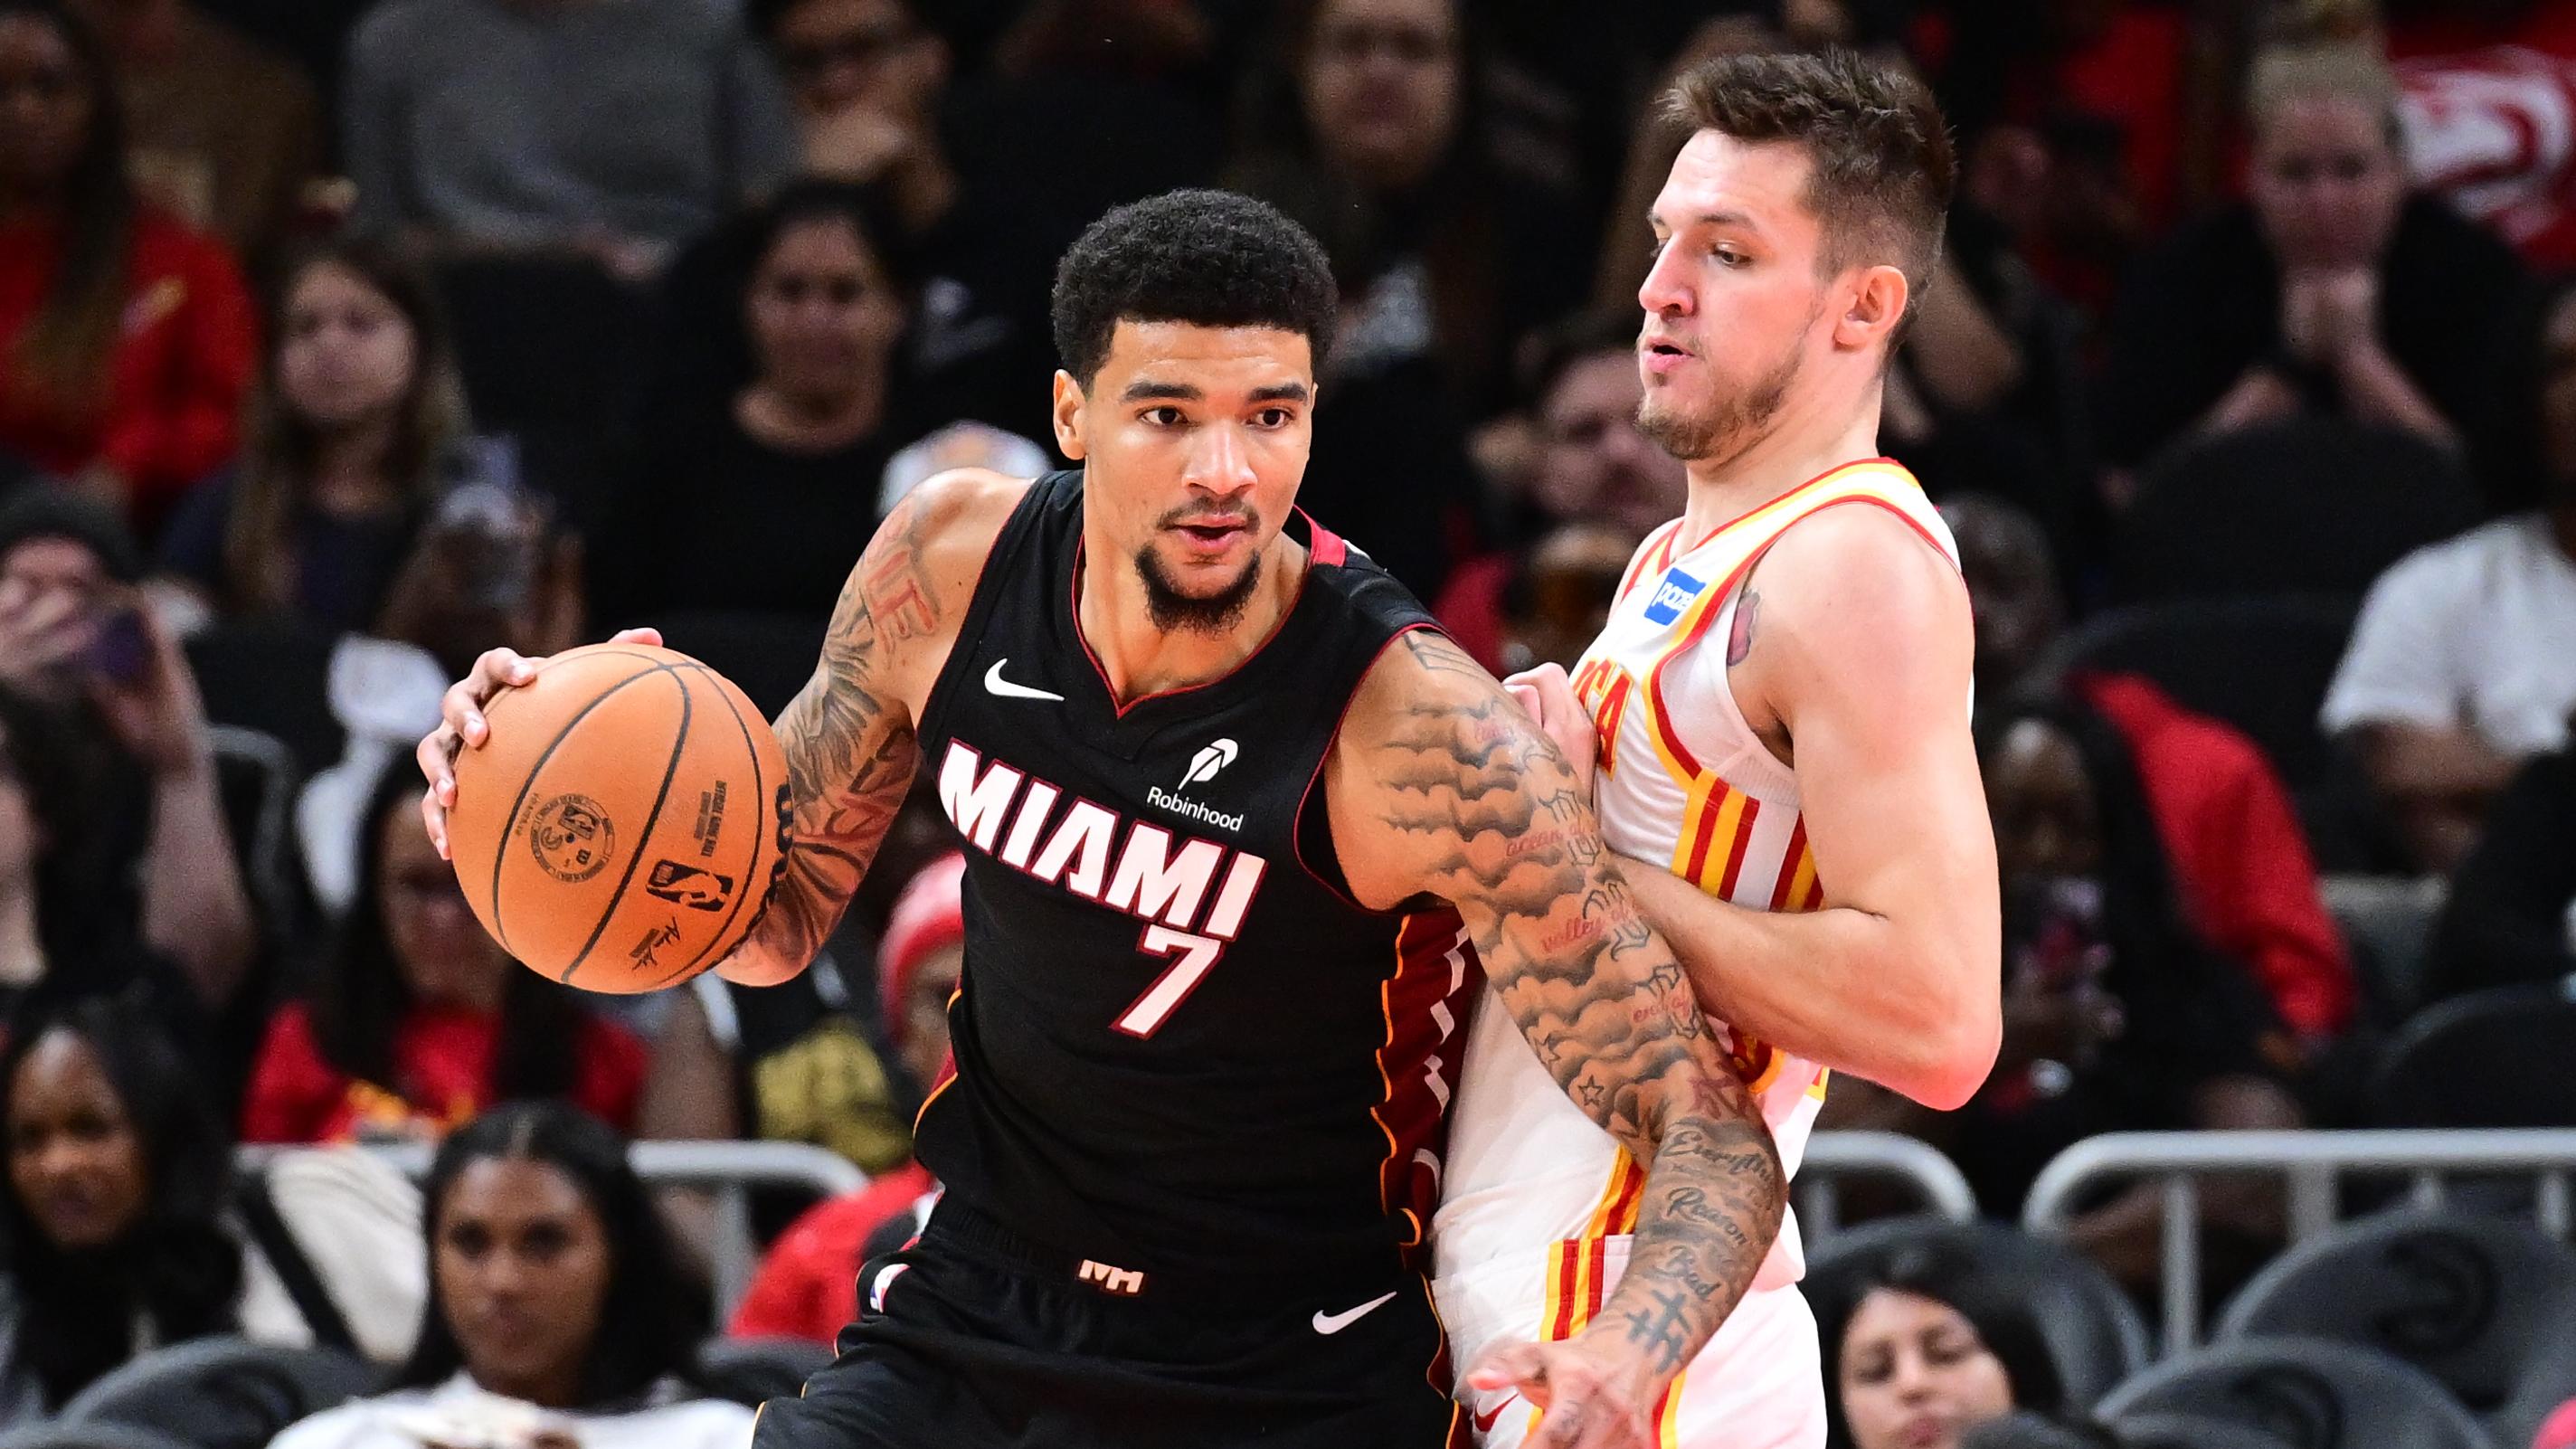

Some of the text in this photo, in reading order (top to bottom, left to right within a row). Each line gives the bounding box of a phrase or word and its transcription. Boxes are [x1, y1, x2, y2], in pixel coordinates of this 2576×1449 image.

[937, 737, 1268, 942] MIAMI
[1147, 786, 1245, 831] Robinhood
[1109, 923, 1226, 1040] 7
